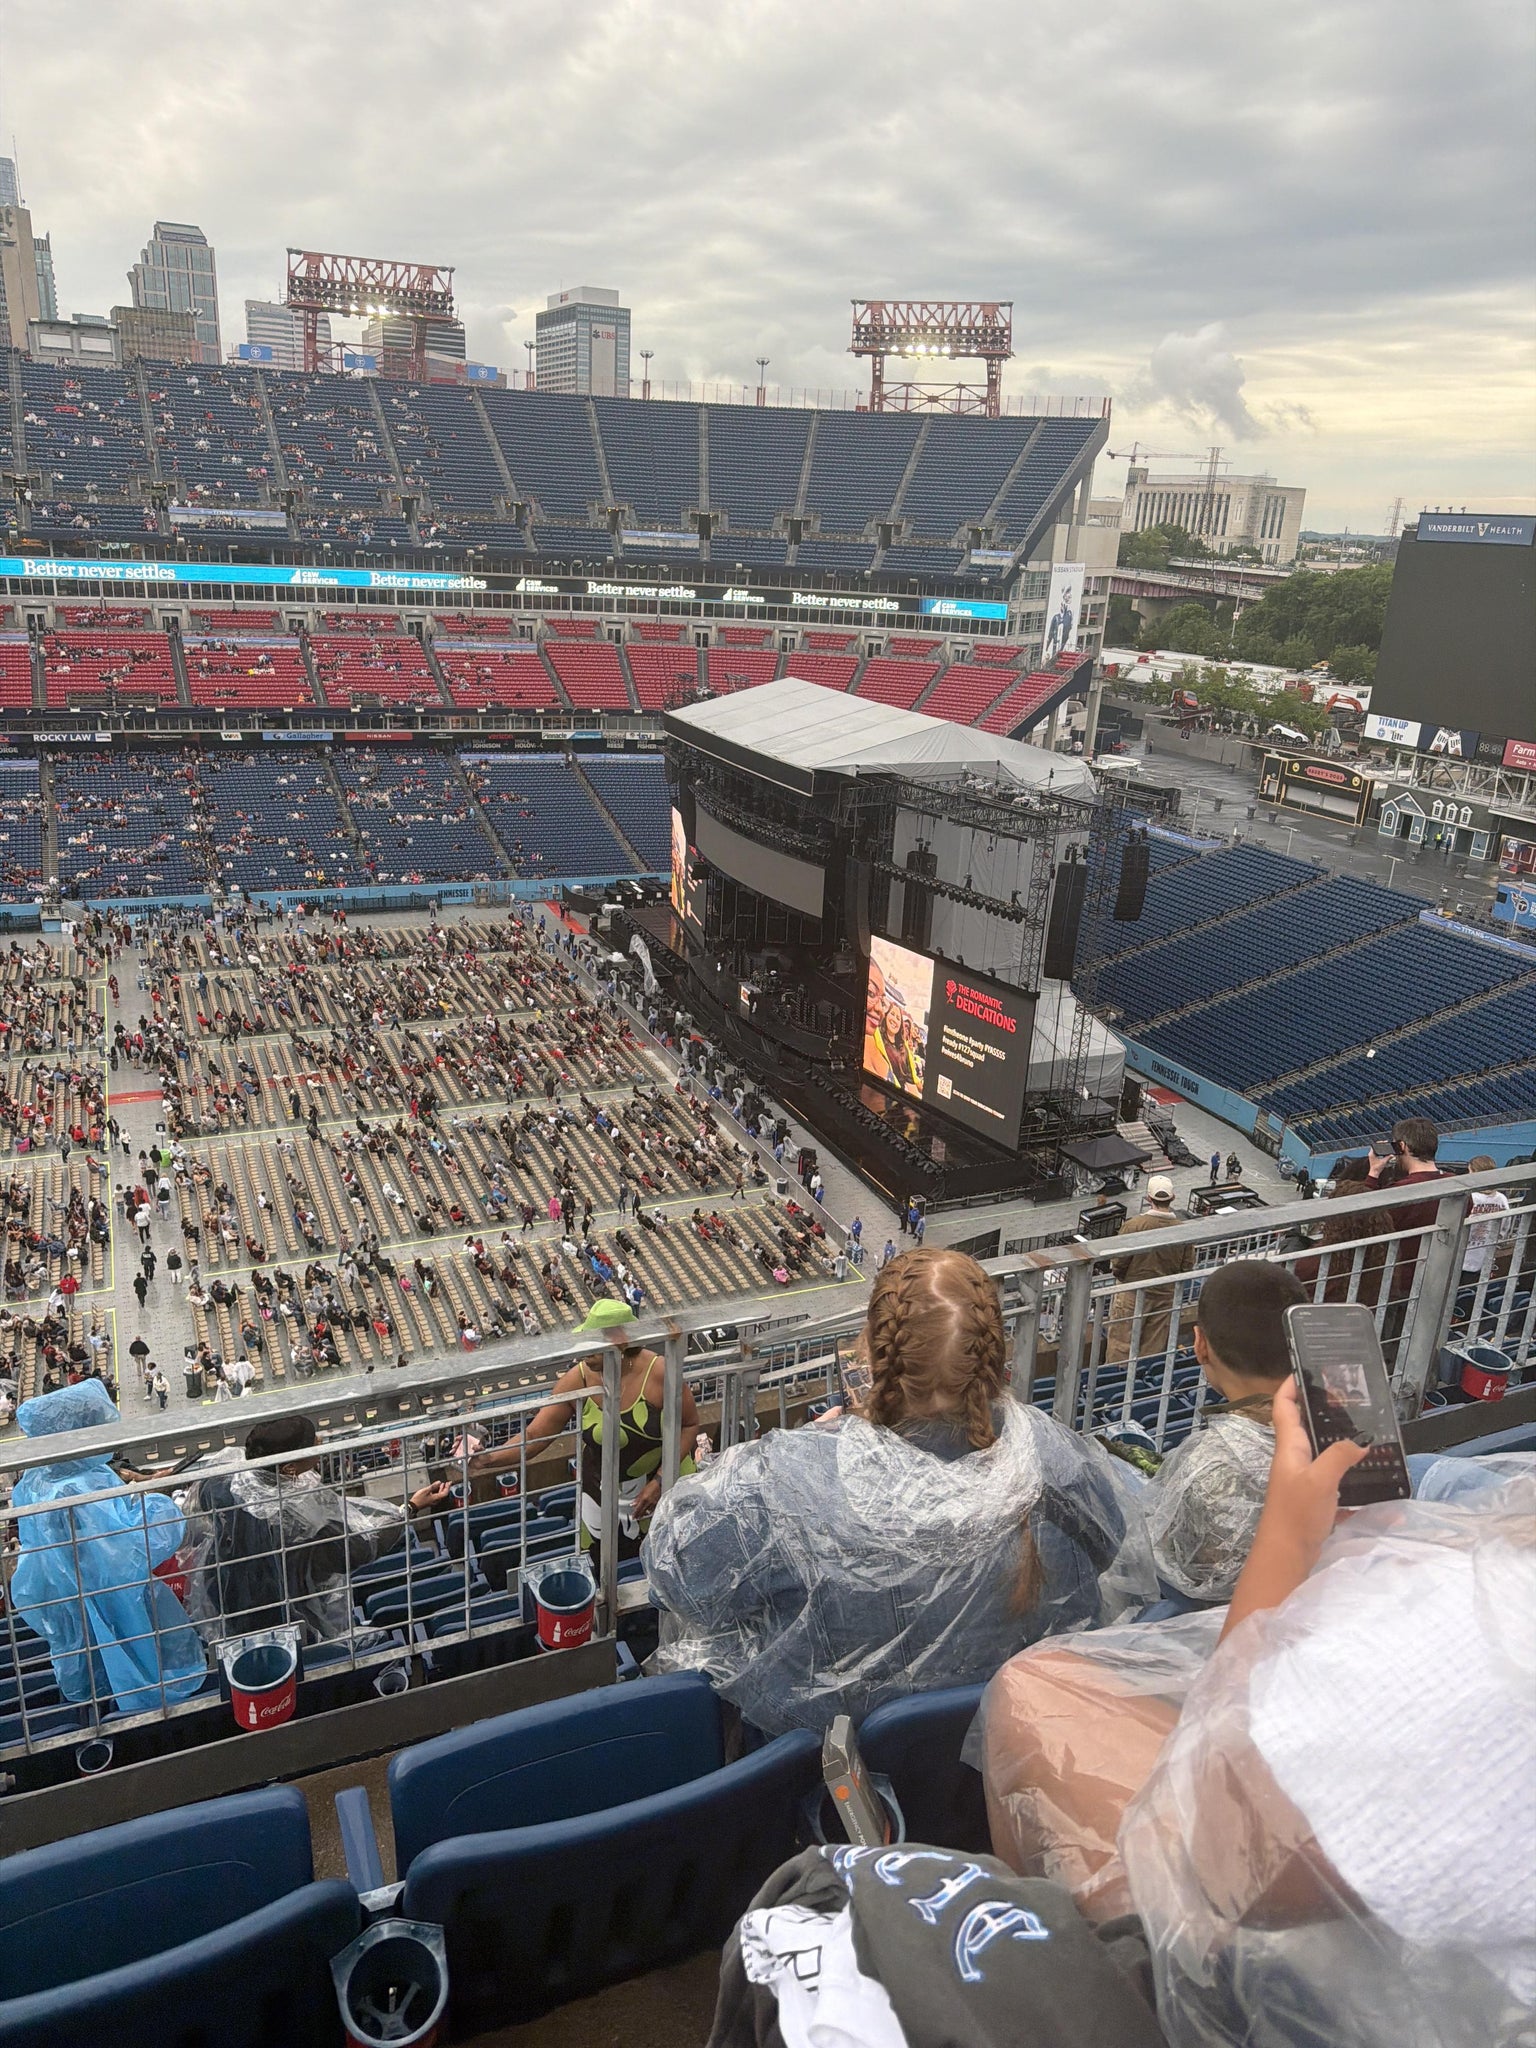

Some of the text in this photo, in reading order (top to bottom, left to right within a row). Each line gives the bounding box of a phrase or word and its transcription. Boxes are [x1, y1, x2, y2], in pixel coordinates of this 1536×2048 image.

[601, 331, 616, 339] UBS
[1428, 524, 1475, 533] VANDERBILT
[1490, 527, 1523, 535] HEALTH
[23, 559, 175, 580] Better never settles
[302, 577, 339, 585] SERVICES
[371, 572, 487, 590] Better never settles
[526, 585, 559, 593] SERVICES
[587, 581, 697, 598] Better never settles
[733, 595, 765, 603] SERVICES
[792, 592, 899, 610] Better never settles
[1378, 717, 1409, 730] TITAN UP
[33, 734, 67, 742] ROCKY
[70, 734, 92, 742] LAW
[286, 732, 323, 740] Gallagher
[1390, 730, 1404, 742] Lite
[1513, 744, 1536, 757] Farm
[958, 983, 1004, 1011] THE ROMANTIC
[956, 994, 1017, 1034] DEDICATIONS
[1151, 1060, 1200, 1095] TENNESSEE TOUGH
[844, 1801, 862, 1835] EMERGENCY
